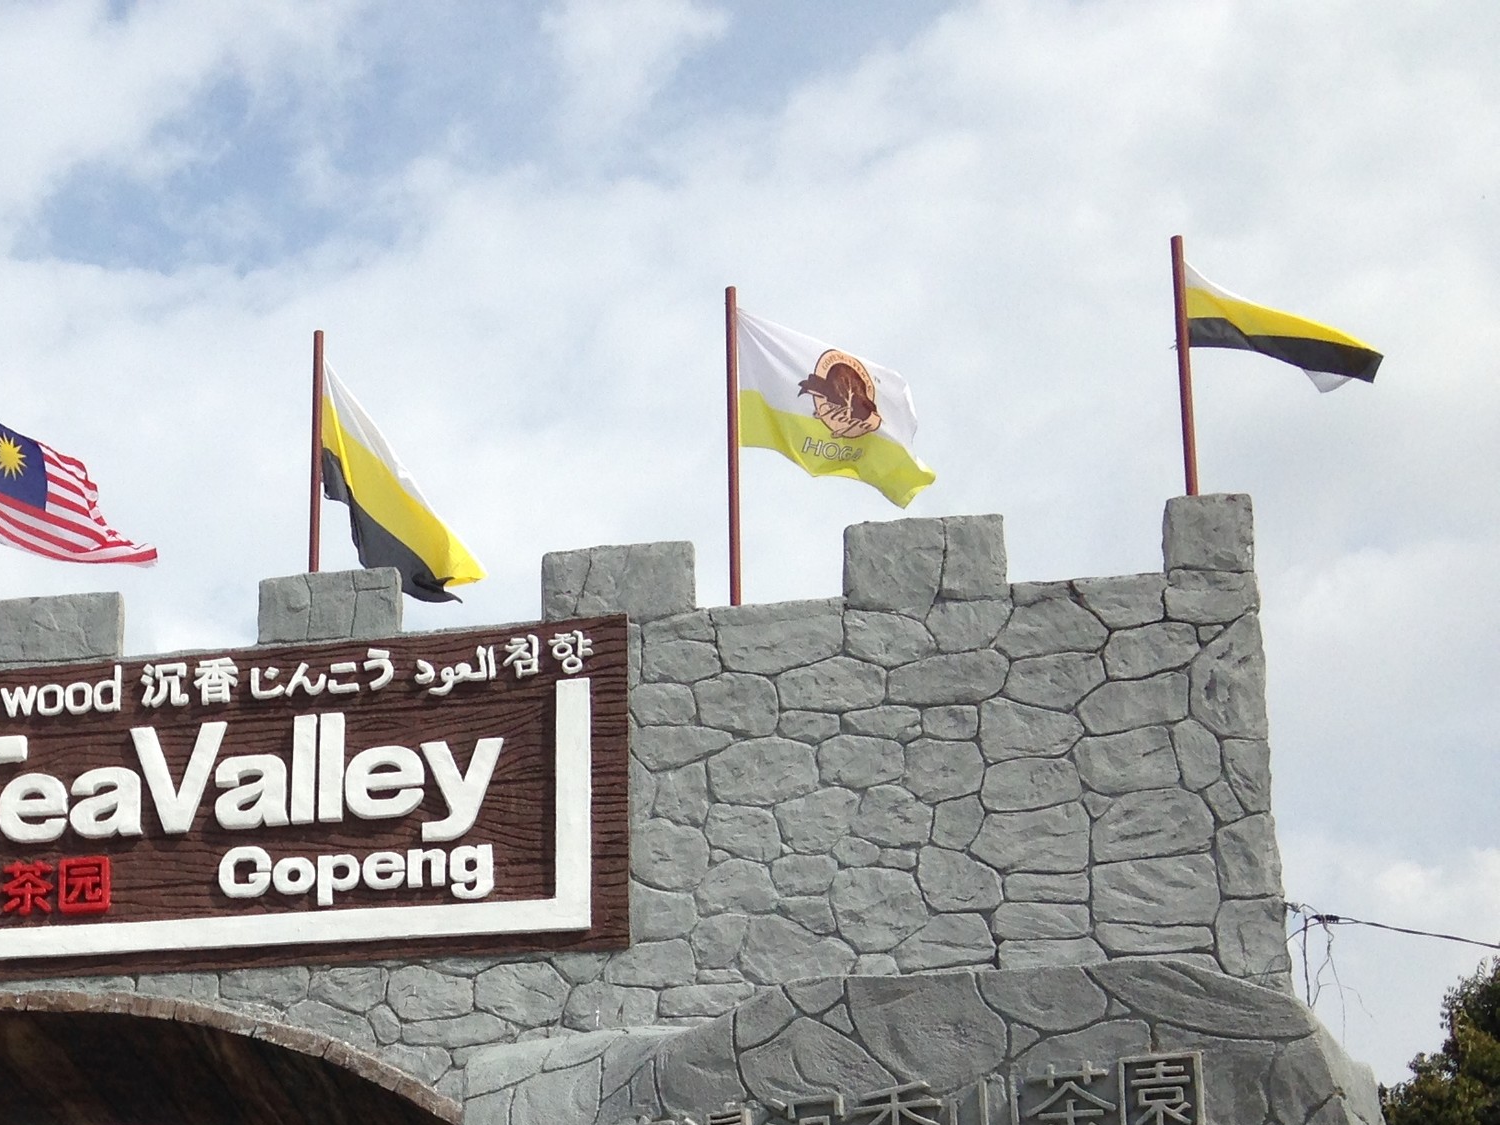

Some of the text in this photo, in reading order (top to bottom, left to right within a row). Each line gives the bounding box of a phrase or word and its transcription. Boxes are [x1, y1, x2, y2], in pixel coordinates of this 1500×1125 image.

[140, 656, 239, 708] 沉香
[250, 647, 395, 700] じんこう
[414, 645, 497, 696] العود
[218, 843, 494, 905] Gopeng
